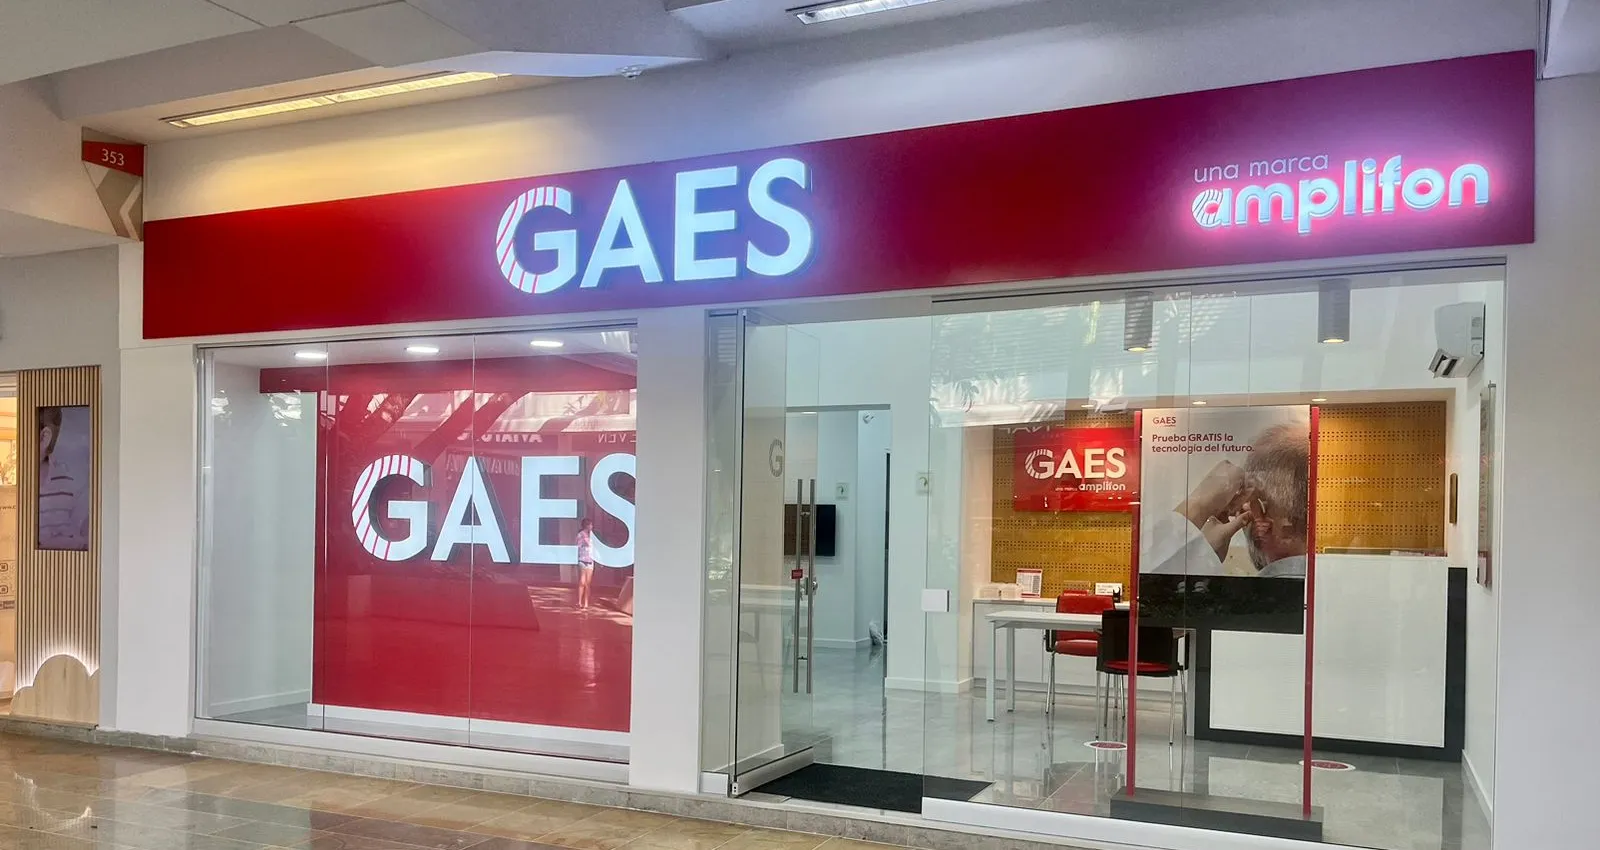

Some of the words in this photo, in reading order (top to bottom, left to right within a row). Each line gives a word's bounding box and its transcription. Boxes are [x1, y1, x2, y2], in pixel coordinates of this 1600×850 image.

[102, 148, 125, 166] 353
[1193, 161, 1239, 183] una
[1249, 154, 1329, 177] marca
[1191, 155, 1490, 234] amplifon
[496, 158, 813, 294] GAES
[1152, 416, 1177, 425] GAES
[1152, 434, 1187, 442] Prueba
[1188, 433, 1223, 442] GRATIS
[1225, 433, 1234, 442] la
[1204, 444, 1220, 453] del
[1221, 444, 1255, 453] futuro.
[1024, 447, 1127, 479] GAES
[1079, 481, 1126, 493] amplifon
[352, 453, 636, 568] GAES
